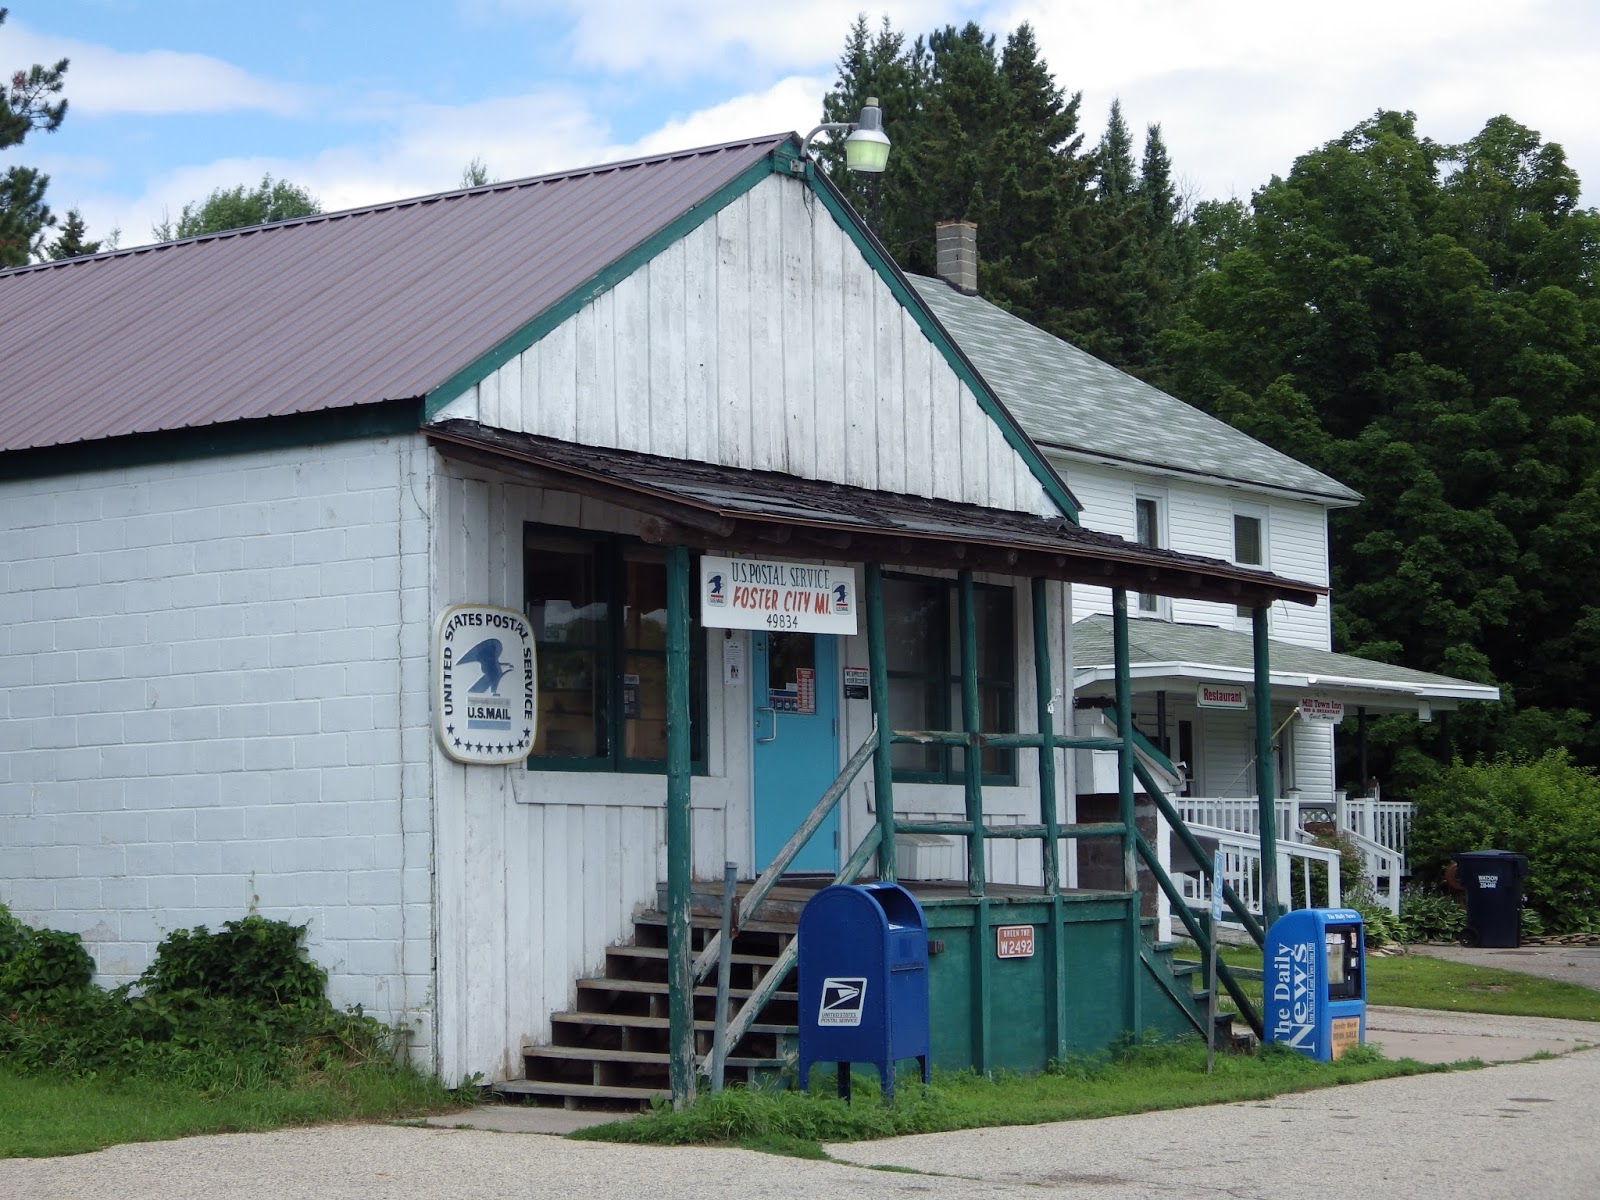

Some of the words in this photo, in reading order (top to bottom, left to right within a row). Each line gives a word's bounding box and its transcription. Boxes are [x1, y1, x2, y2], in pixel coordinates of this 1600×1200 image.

[790, 567, 830, 589] SERVICE
[732, 585, 778, 610] FOSTER
[783, 590, 811, 613] CITY
[444, 613, 483, 642] STATES
[485, 614, 529, 645] POSTAL
[766, 613, 799, 629] 49834
[443, 646, 453, 716] UNITED
[522, 647, 533, 720] SERVICE
[1203, 687, 1242, 703] Restaurant
[1302, 698, 1313, 707] Mill
[1313, 699, 1330, 709] Town
[1331, 700, 1342, 710] Inn
[1273, 943, 1295, 1002] Daily
[1289, 943, 1315, 1053] News
